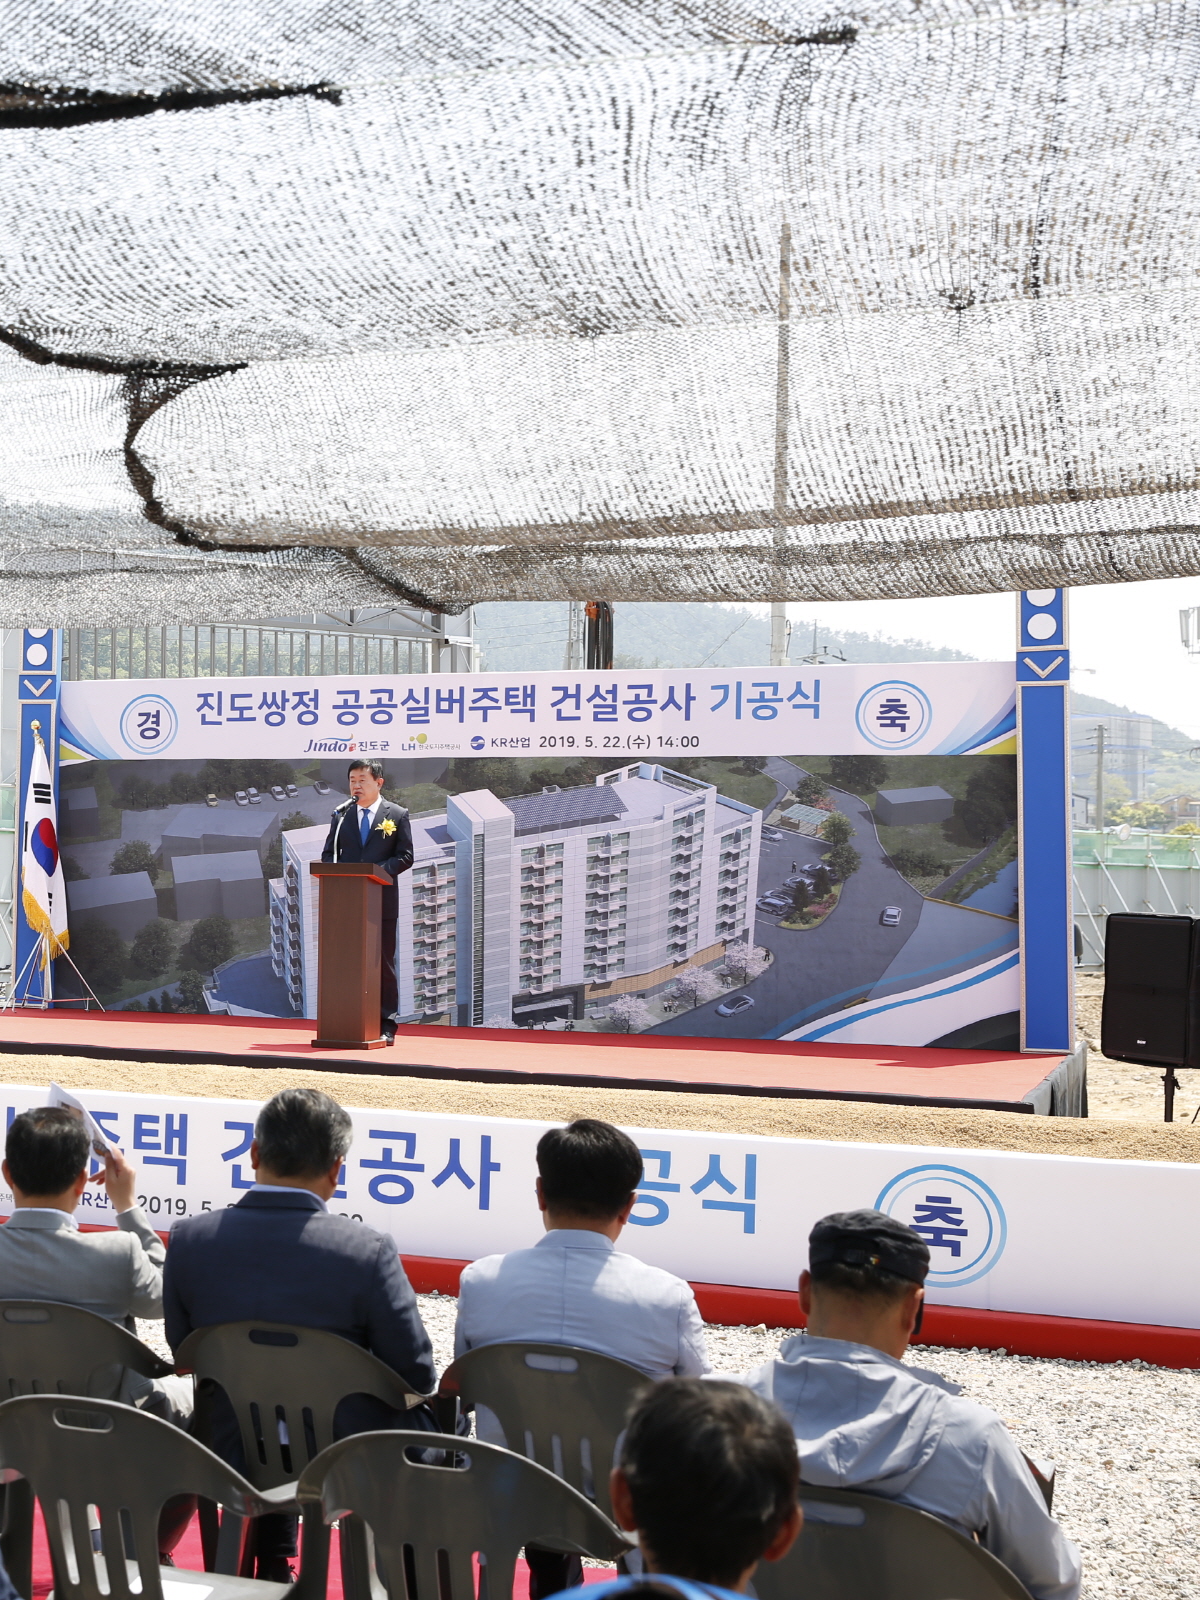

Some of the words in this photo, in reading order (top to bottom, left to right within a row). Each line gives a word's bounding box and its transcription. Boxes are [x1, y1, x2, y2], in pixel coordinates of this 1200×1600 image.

[196, 689, 320, 727] 진도쌍정
[332, 685, 537, 726] 공공실버주택
[550, 682, 696, 722] 건설공사
[710, 679, 821, 720] 기공식
[136, 710, 162, 741] 경
[876, 698, 911, 732] 축
[304, 737, 348, 752] Jindo
[358, 741, 390, 751] 진도군
[402, 743, 416, 751] LH
[491, 736, 531, 749] KR산업
[539, 736, 580, 748] 2019.
[657, 735, 700, 748] 14:00
[627, 1149, 757, 1234] 공식
[909, 1195, 968, 1258] 축
